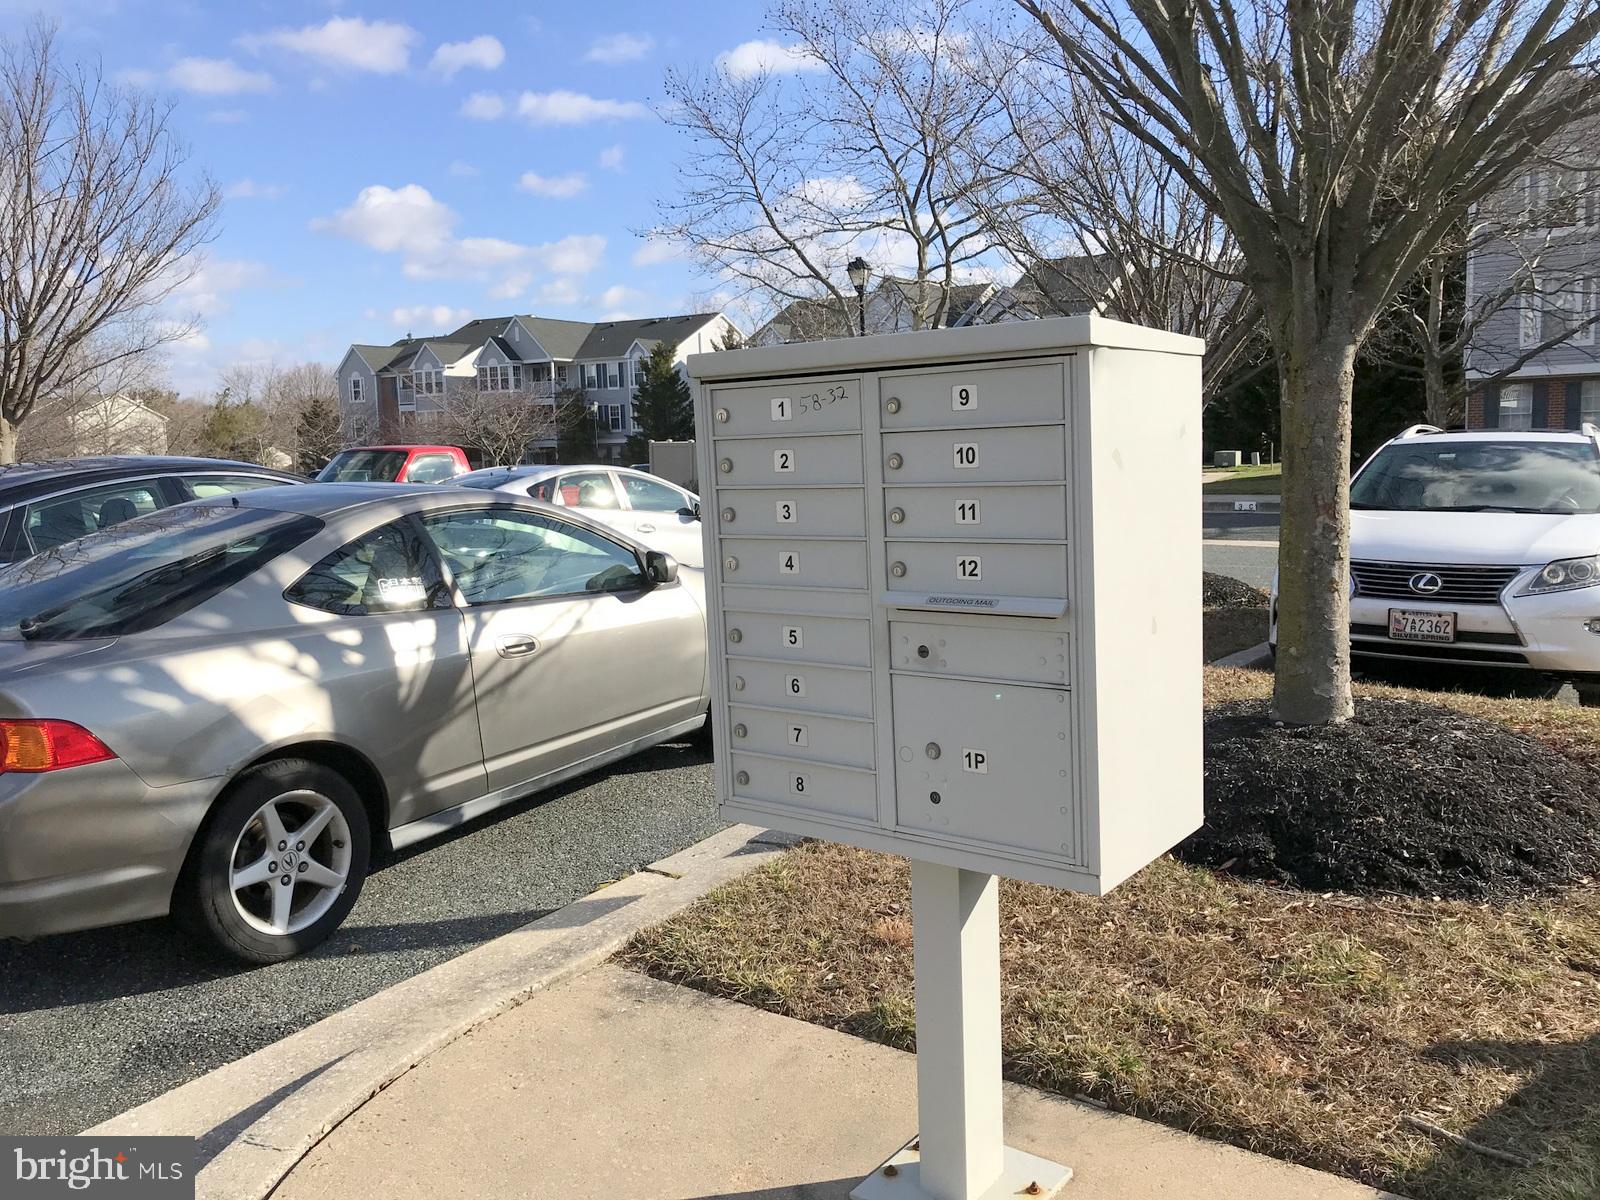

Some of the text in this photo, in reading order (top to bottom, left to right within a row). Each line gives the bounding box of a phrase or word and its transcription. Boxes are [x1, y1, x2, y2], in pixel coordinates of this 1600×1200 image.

[958, 388, 970, 407] 9
[777, 400, 785, 418] 1
[780, 453, 789, 469] 2
[956, 446, 976, 465] 10
[782, 504, 791, 520] 3
[958, 503, 976, 521] 11
[784, 554, 795, 571] 4
[958, 559, 979, 577] 12
[928, 597, 973, 605] OUTGOING
[788, 629, 798, 645] 5
[1392, 632, 1419, 640] SILVER
[791, 678, 800, 694] 6
[793, 727, 802, 743] 7
[964, 751, 986, 770] 1P
[796, 776, 805, 792] 8
